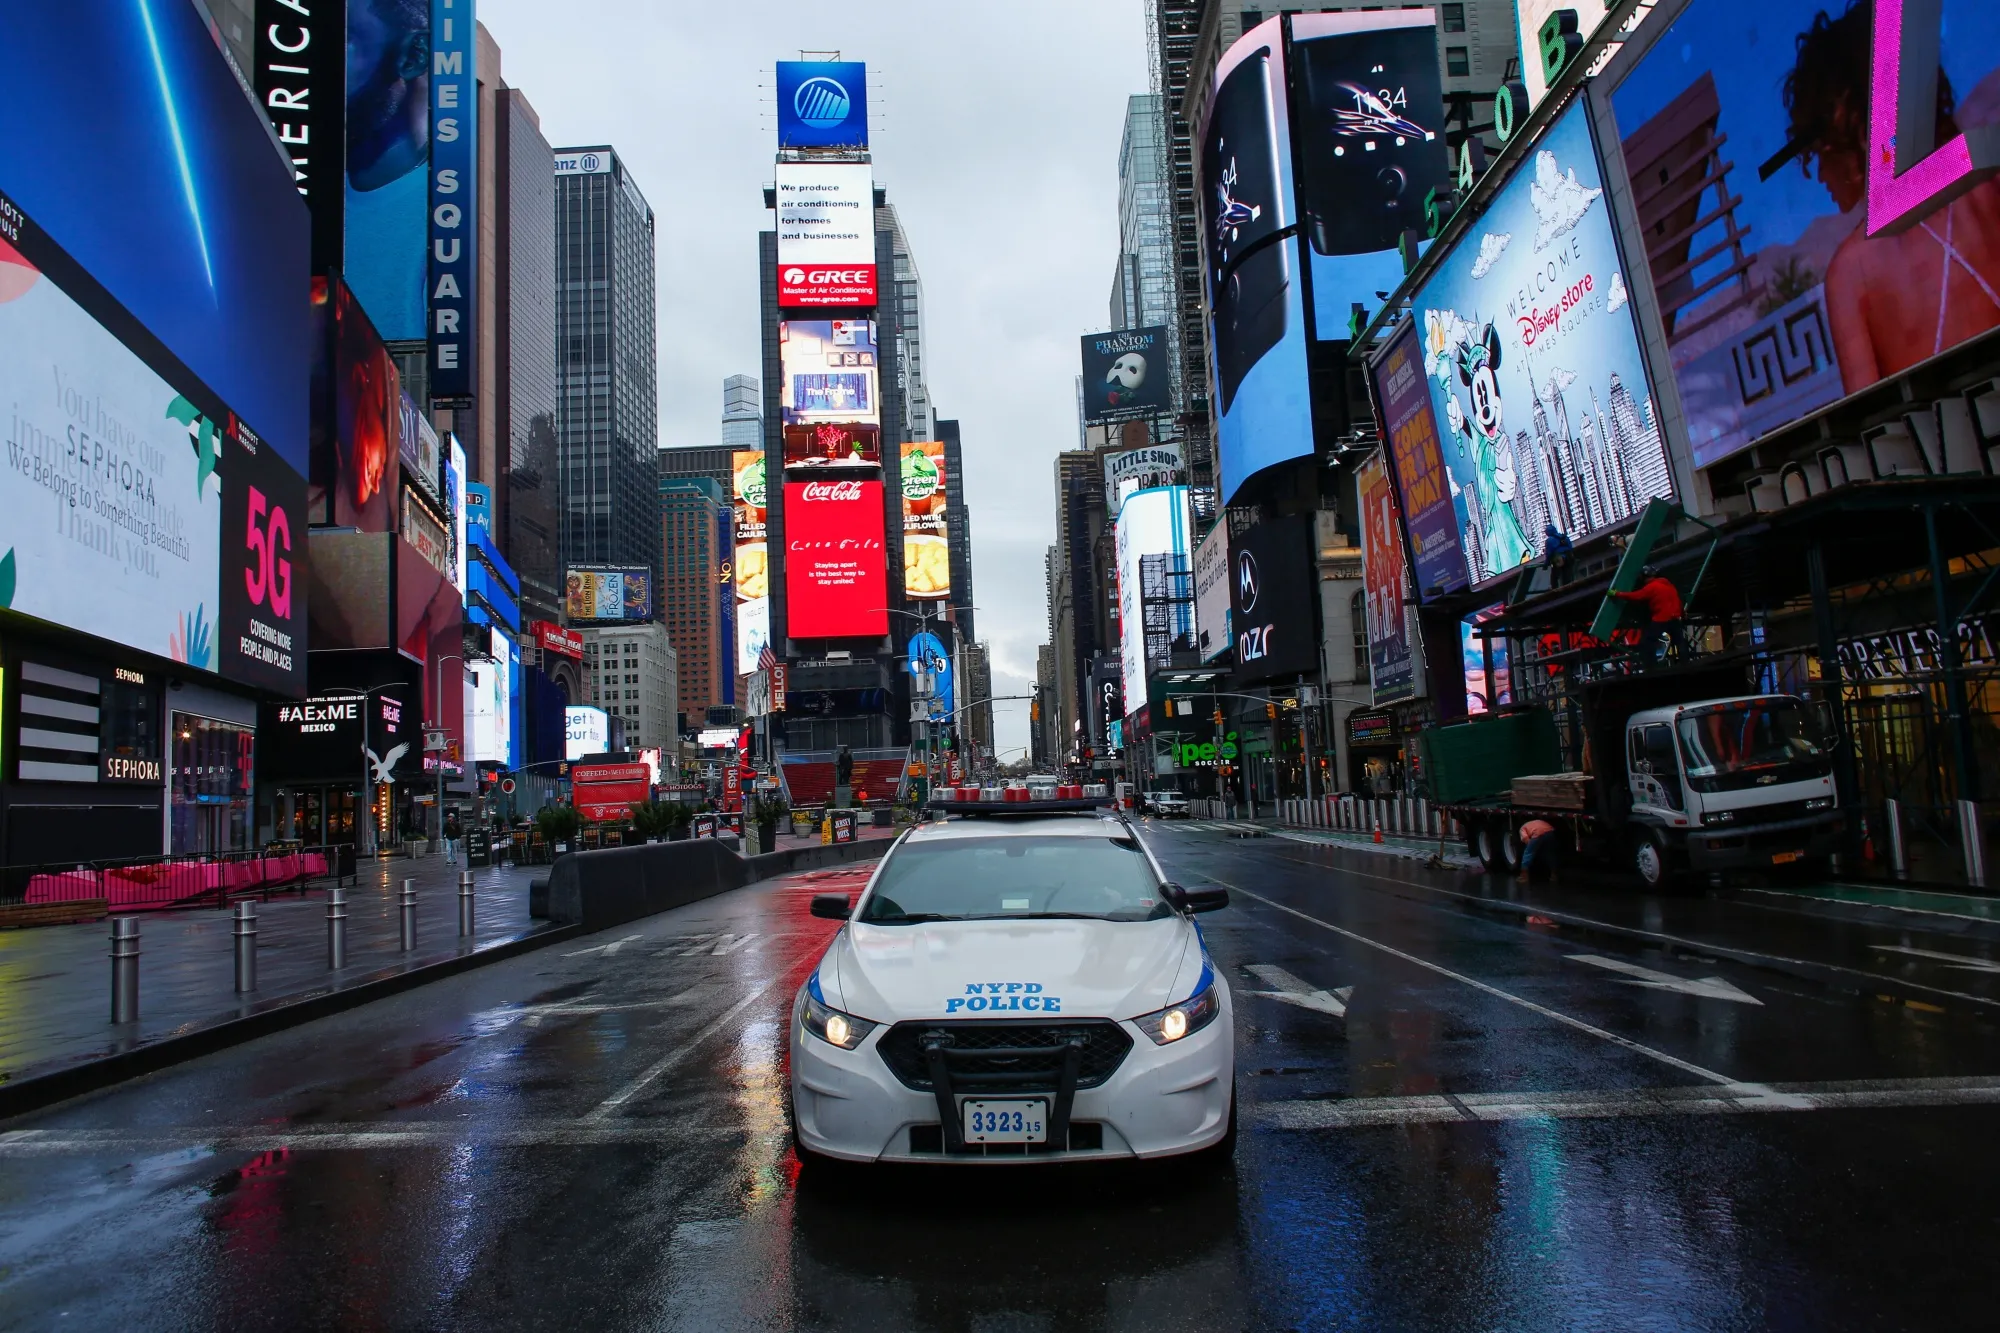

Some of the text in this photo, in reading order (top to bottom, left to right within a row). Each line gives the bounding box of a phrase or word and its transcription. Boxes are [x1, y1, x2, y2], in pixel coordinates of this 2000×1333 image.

[434, 0, 463, 142] IMES
[800, 185, 839, 193] produce
[434, 169, 463, 369] SQUARE
[808, 270, 869, 284] GREE
[1506, 237, 1581, 318] WELCOME
[829, 287, 873, 295] Conditioning
[1561, 274, 1594, 313] store
[1529, 334, 1557, 363] TIMES
[1561, 295, 1602, 337] SQUARE
[1095, 334, 1154, 351] PHANTOM
[1126, 343, 1149, 351] OPERA
[1394, 407, 1432, 460] COME
[67, 423, 156, 506] SEPHORA
[1112, 450, 1178, 476] LITTLE SHOP
[6, 440, 191, 562] We Belong to Something Beautiful
[803, 481, 864, 501] Coca-Cola
[903, 485, 937, 496] Giant
[1409, 466, 1442, 520] AWAY
[245, 485, 292, 620] 5G
[583, 574, 592, 590] KING
[584, 590, 592, 605] LION
[606, 575, 619, 616] FROZEN
[250, 618, 292, 651] COVERING MORE
[240, 636, 292, 672] PEOPLE AND PLACES
[115, 668, 144, 684] SEPHORA
[774, 666, 786, 709] HELLO!
[301, 723, 336, 733] MEXICO
[107, 758, 160, 780] SEPHORA
[575, 770, 608, 778] COFFEED
[728, 769, 739, 789] tkts
[965, 983, 1043, 994] NYPD
[946, 996, 1061, 1013] POLICE
[972, 1111, 1041, 1132] 3323 15
